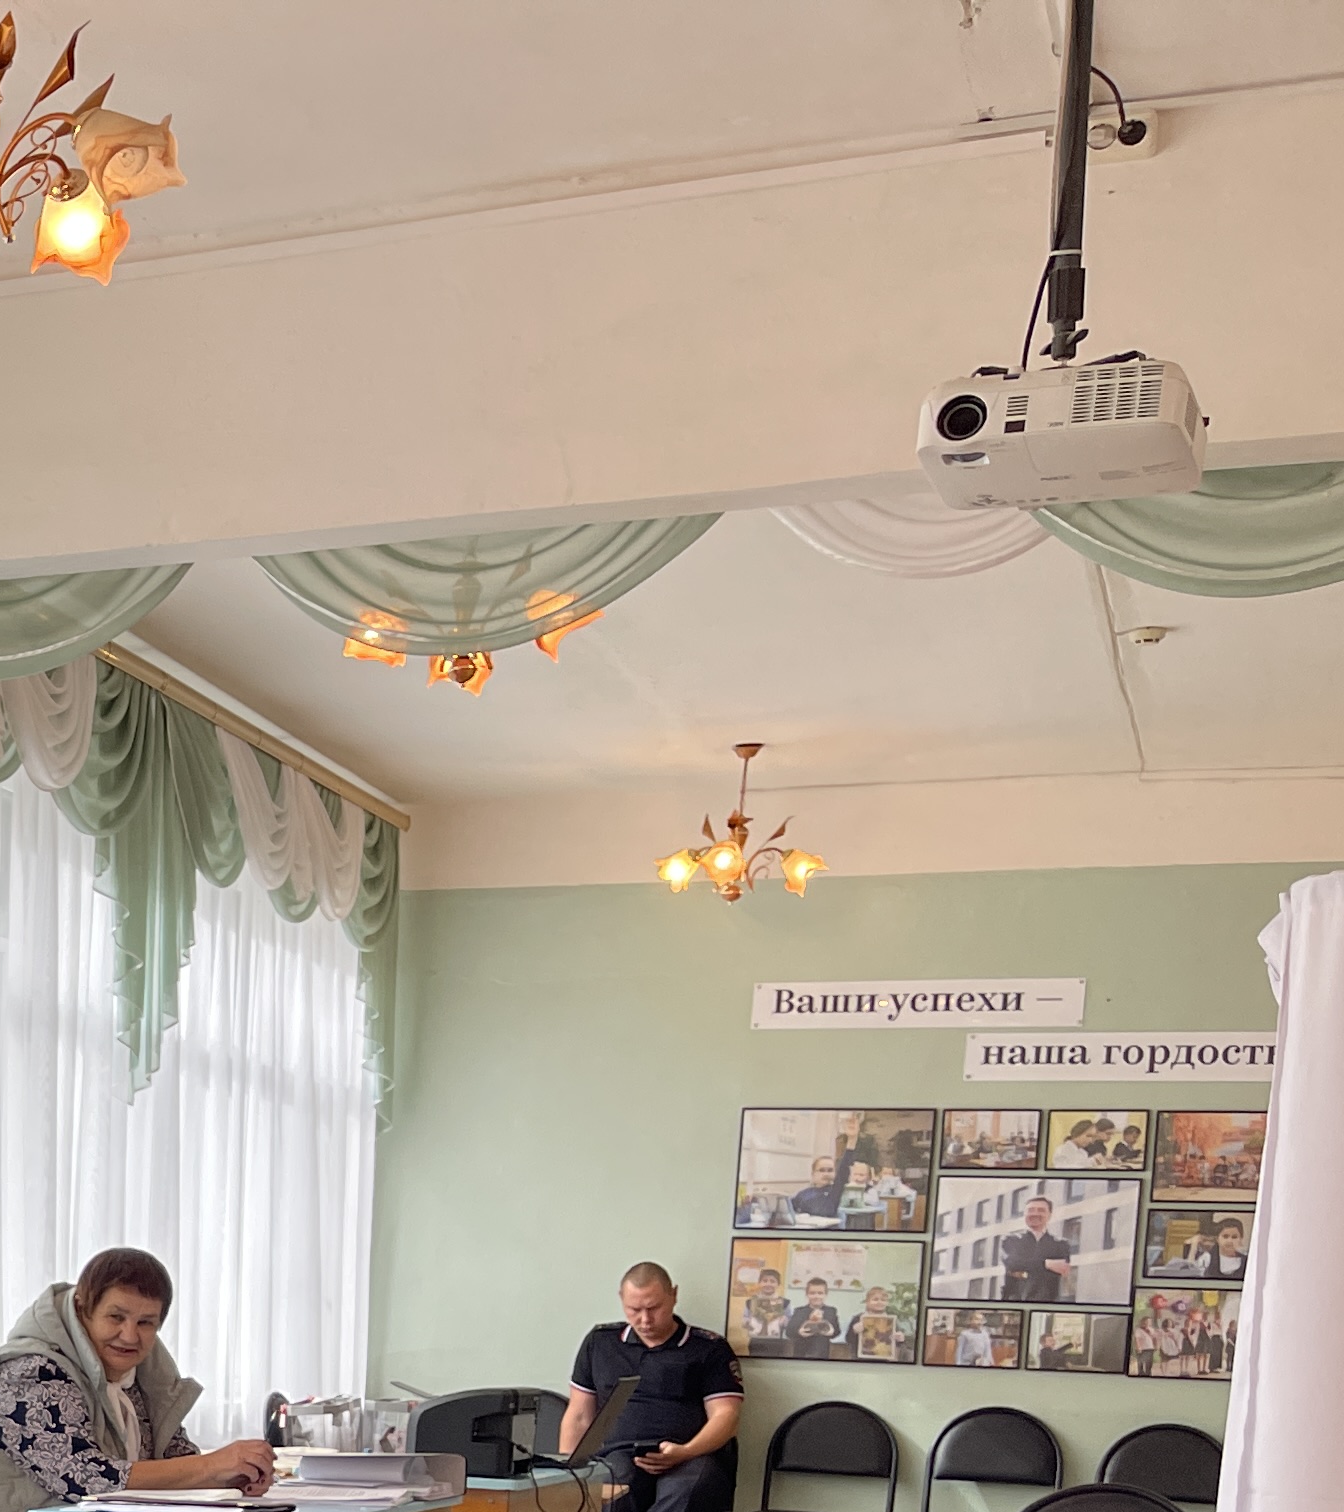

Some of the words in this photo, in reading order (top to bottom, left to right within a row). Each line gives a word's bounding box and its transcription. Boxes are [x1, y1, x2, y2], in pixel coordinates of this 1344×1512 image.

[773, 989, 877, 1014] Ваши
[887, 991, 1025, 1021] успехи
[981, 1044, 1091, 1065] наша
